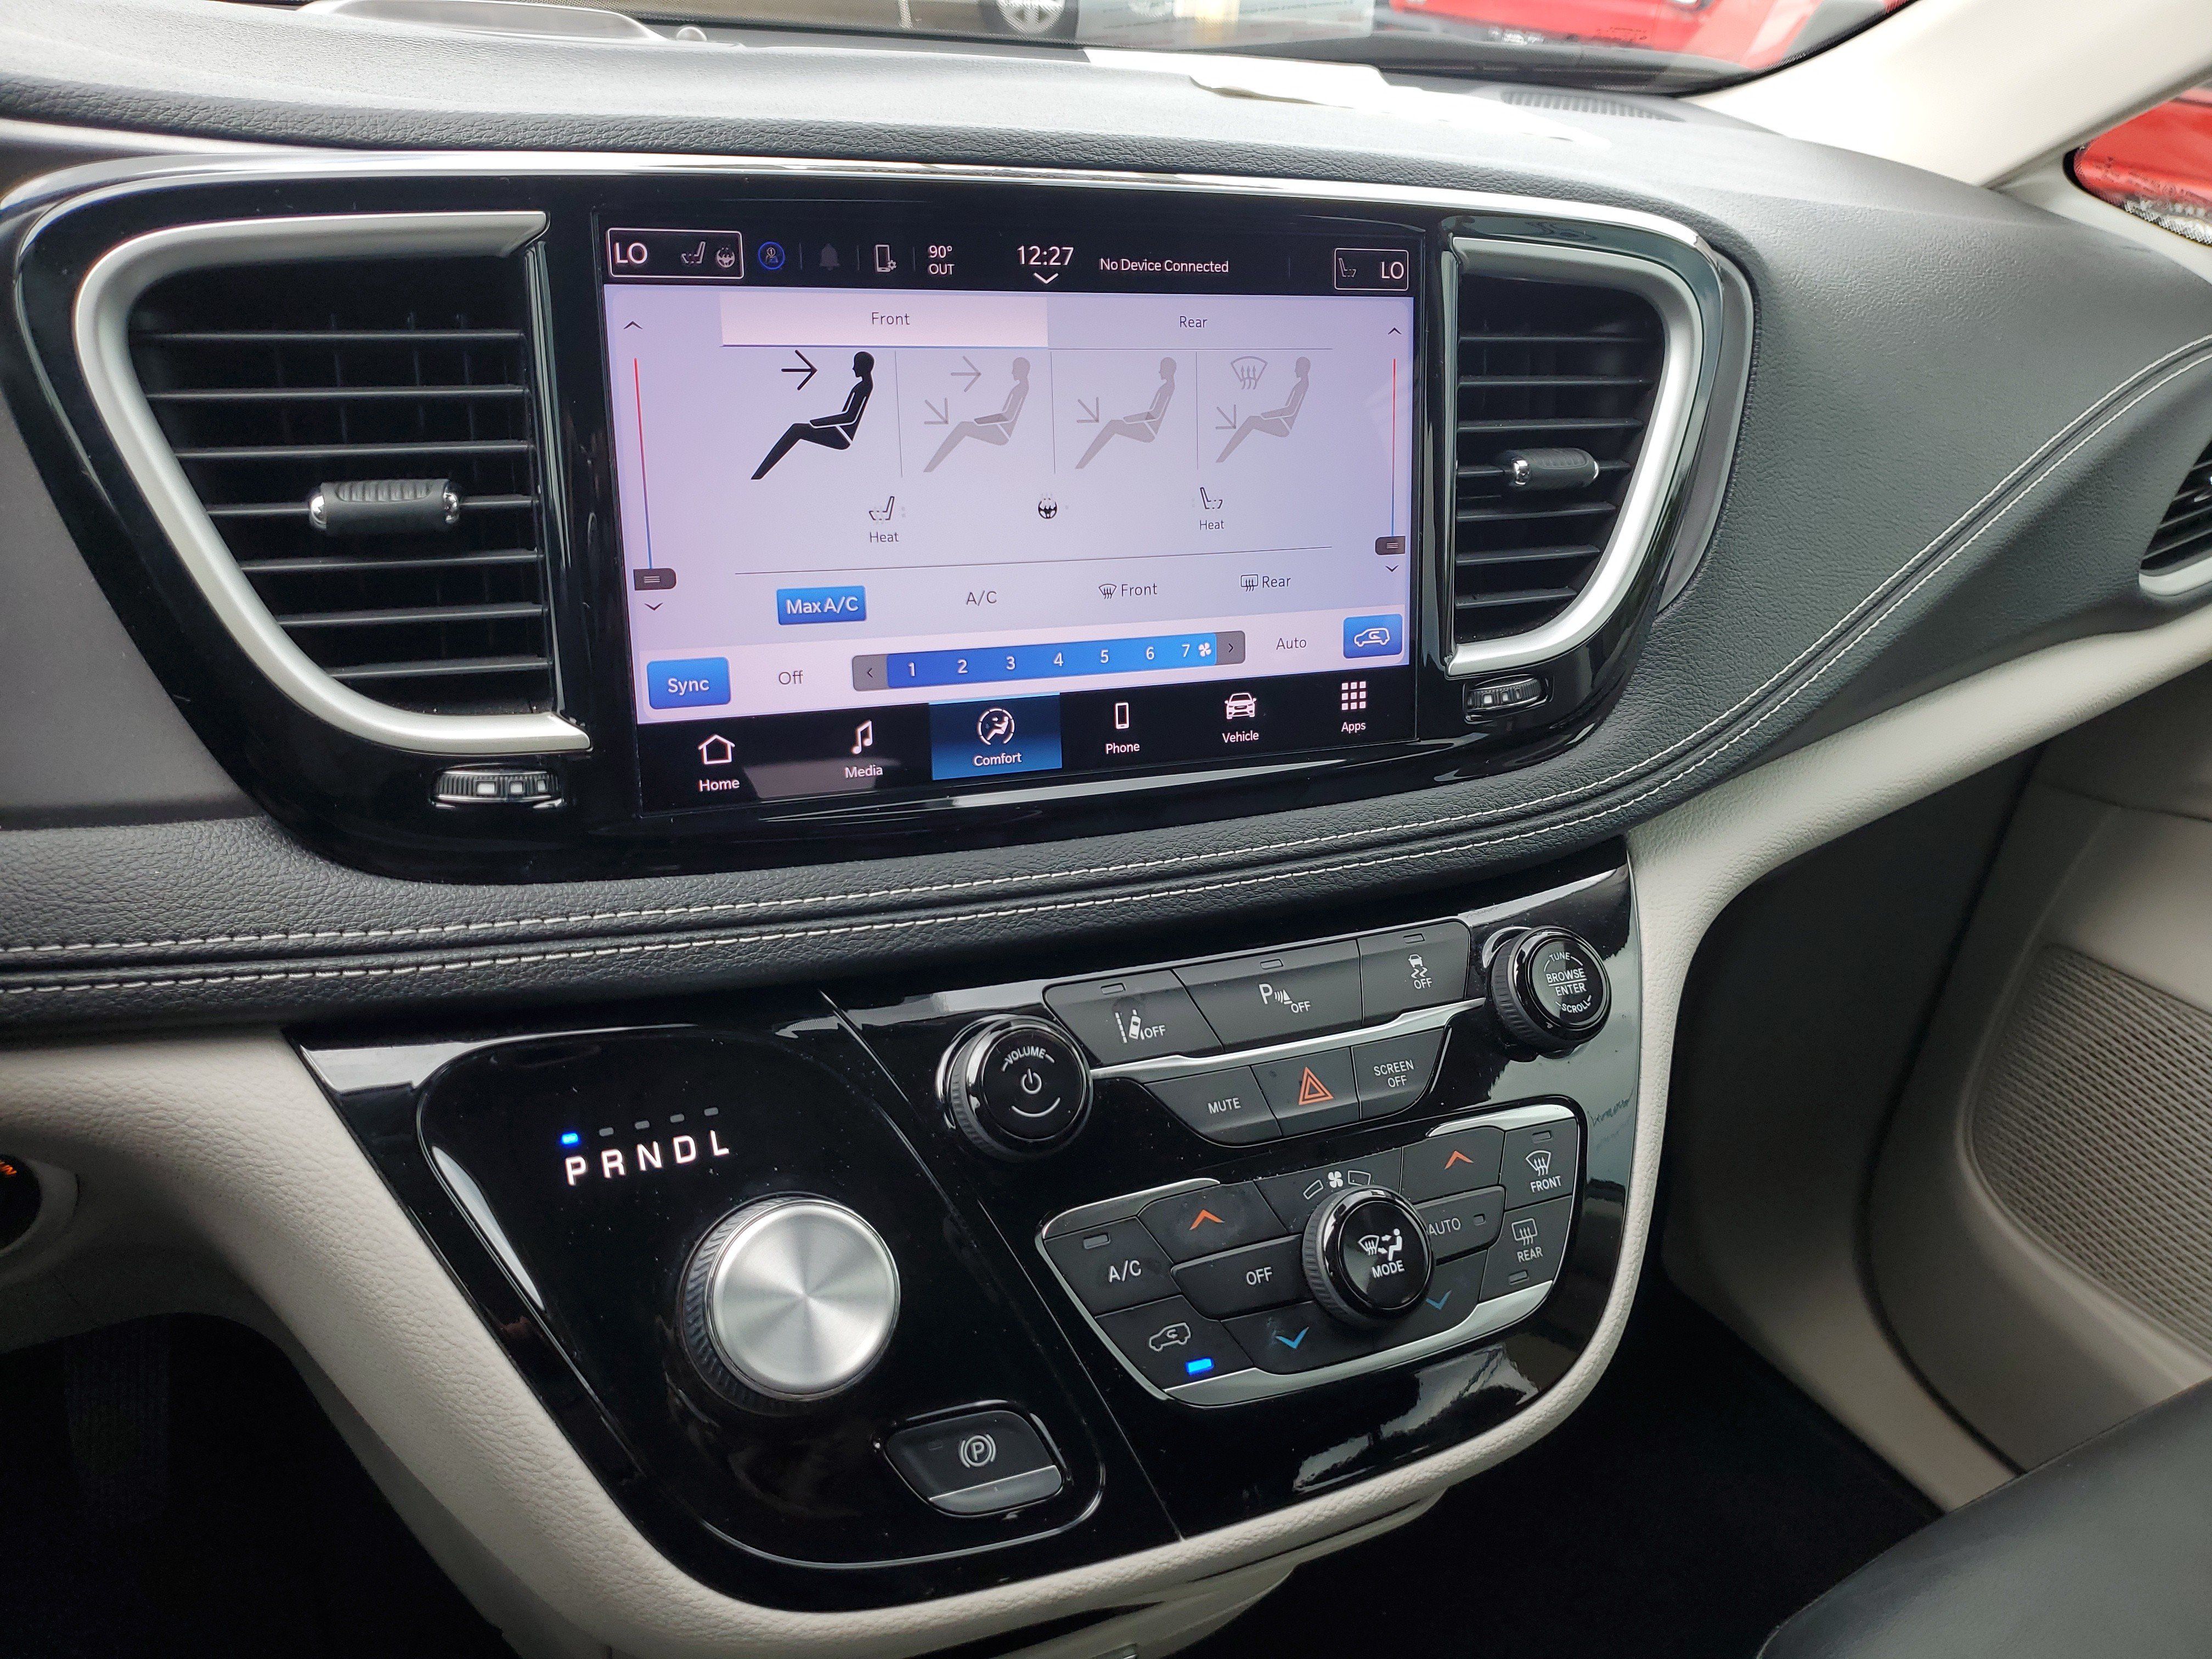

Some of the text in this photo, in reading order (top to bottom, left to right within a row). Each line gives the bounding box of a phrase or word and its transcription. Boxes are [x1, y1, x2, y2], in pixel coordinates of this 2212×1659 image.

[615, 242, 648, 264] LO
[1017, 246, 1074, 266] 12:27
[928, 263, 954, 275] OUT
[1100, 258, 1229, 273] No Device Connected
[1380, 261, 1404, 279] LO
[872, 312, 910, 326] Front
[1180, 315, 1207, 328] Rear
[1199, 520, 1224, 530] Heat
[870, 532, 899, 543] Heat
[1262, 575, 1291, 588] Rear
[1121, 583, 1157, 597] Front
[786, 596, 859, 614] Max A/C
[966, 591, 997, 606] A/C
[1276, 637, 1307, 650] Auto
[909, 644, 1190, 677] 1 2 3 4 5 6 7
[778, 670, 803, 685] Off
[668, 677, 709, 695] Sync
[1341, 721, 1366, 733] Apps
[1222, 730, 1259, 742] Vehicle
[1105, 741, 1140, 754] Phone
[973, 752, 1022, 766] Comfort
[844, 765, 883, 778] Media
[699, 777, 740, 792] Home
[1549, 952, 1571, 962] TUNE
[1545, 968, 1586, 983] BROWSE
[1414, 978, 1432, 989] OFF
[1555, 983, 1587, 996] ENTER
[1291, 1001, 1311, 1013] OFF
[1561, 1000, 1591, 1013] SCROLL
[1144, 1025, 1166, 1038] OFF
[1006, 1045, 1046, 1064] VOLUME
[1373, 1059, 1414, 1076] SCREEN
[1388, 1075, 1407, 1088] OFF
[1208, 1098, 1242, 1114] MUTE
[1530, 1176, 1561, 1193] FRONT
[1428, 1217, 1461, 1236] AUTO
[1516, 1246, 1543, 1263] REAR
[1108, 1260, 1142, 1283] A/C
[1246, 1267, 1273, 1286] OFF
[1372, 1260, 1405, 1279] MODE
